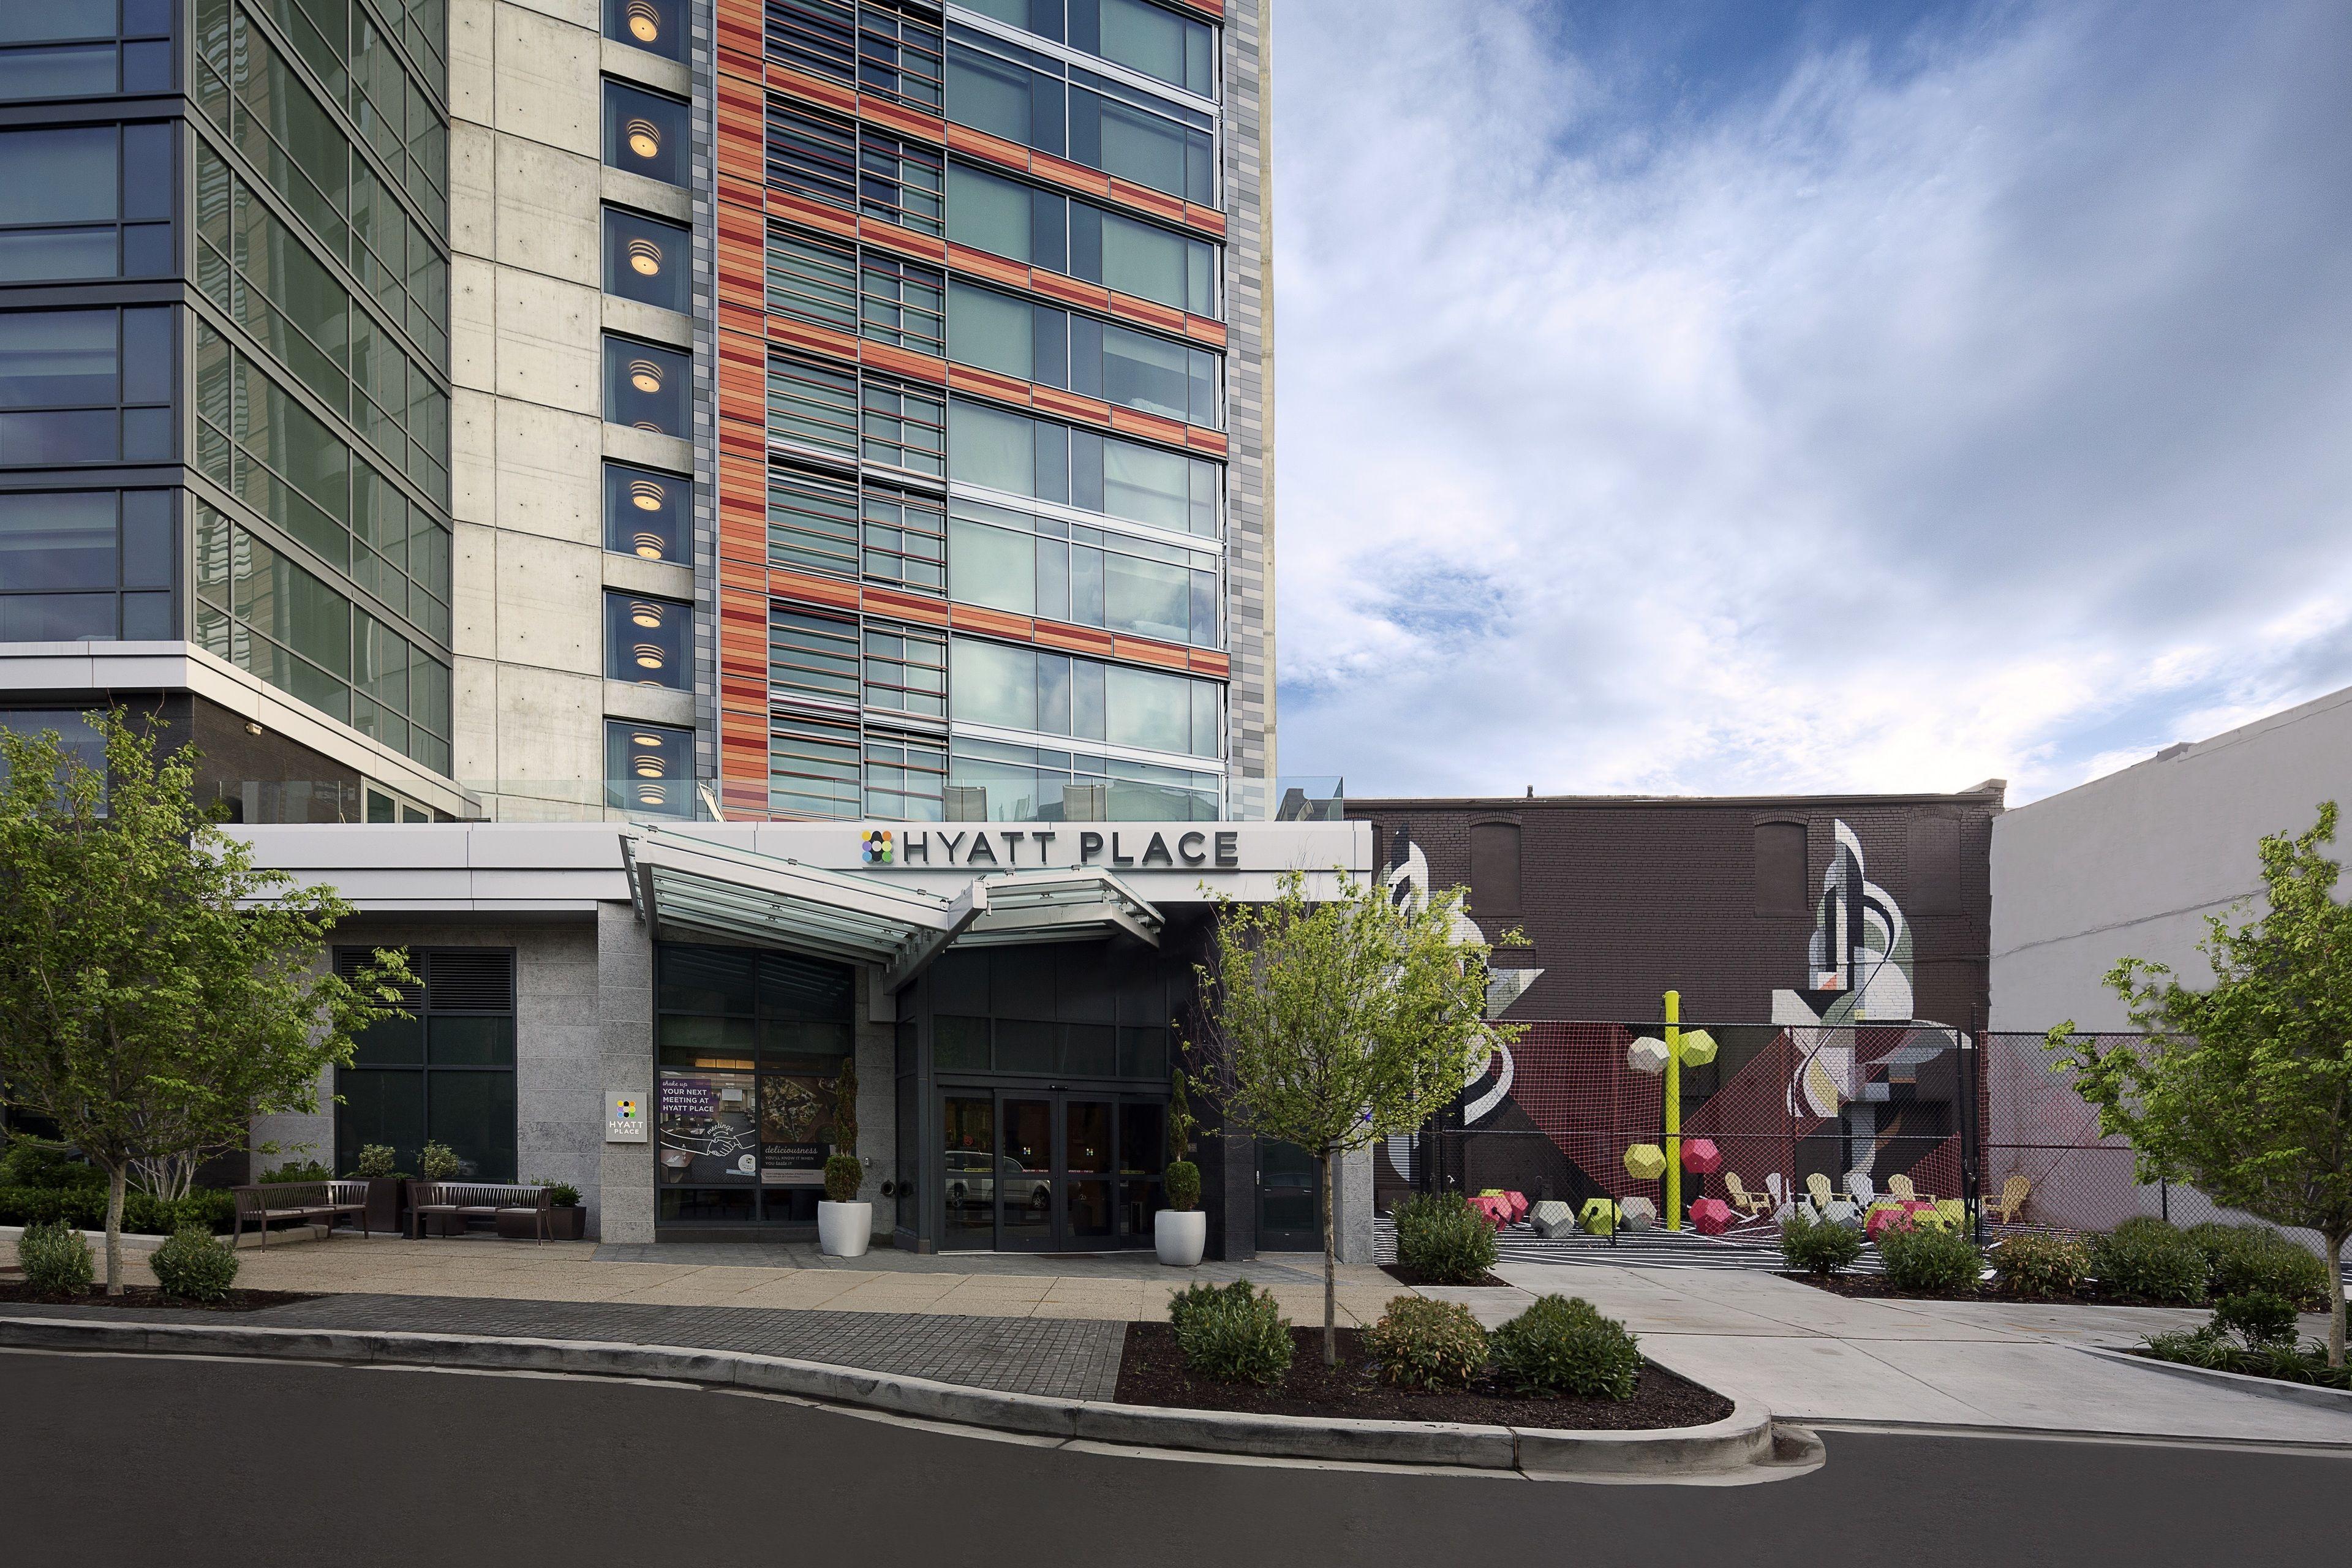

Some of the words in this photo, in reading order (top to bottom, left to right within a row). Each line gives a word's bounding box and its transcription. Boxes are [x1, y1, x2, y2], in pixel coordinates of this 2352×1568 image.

[903, 831, 1056, 864] HYATT
[1080, 831, 1238, 865] PLACE
[707, 1120, 734, 1135] meetings
[765, 1145, 818, 1154] deliciousness
